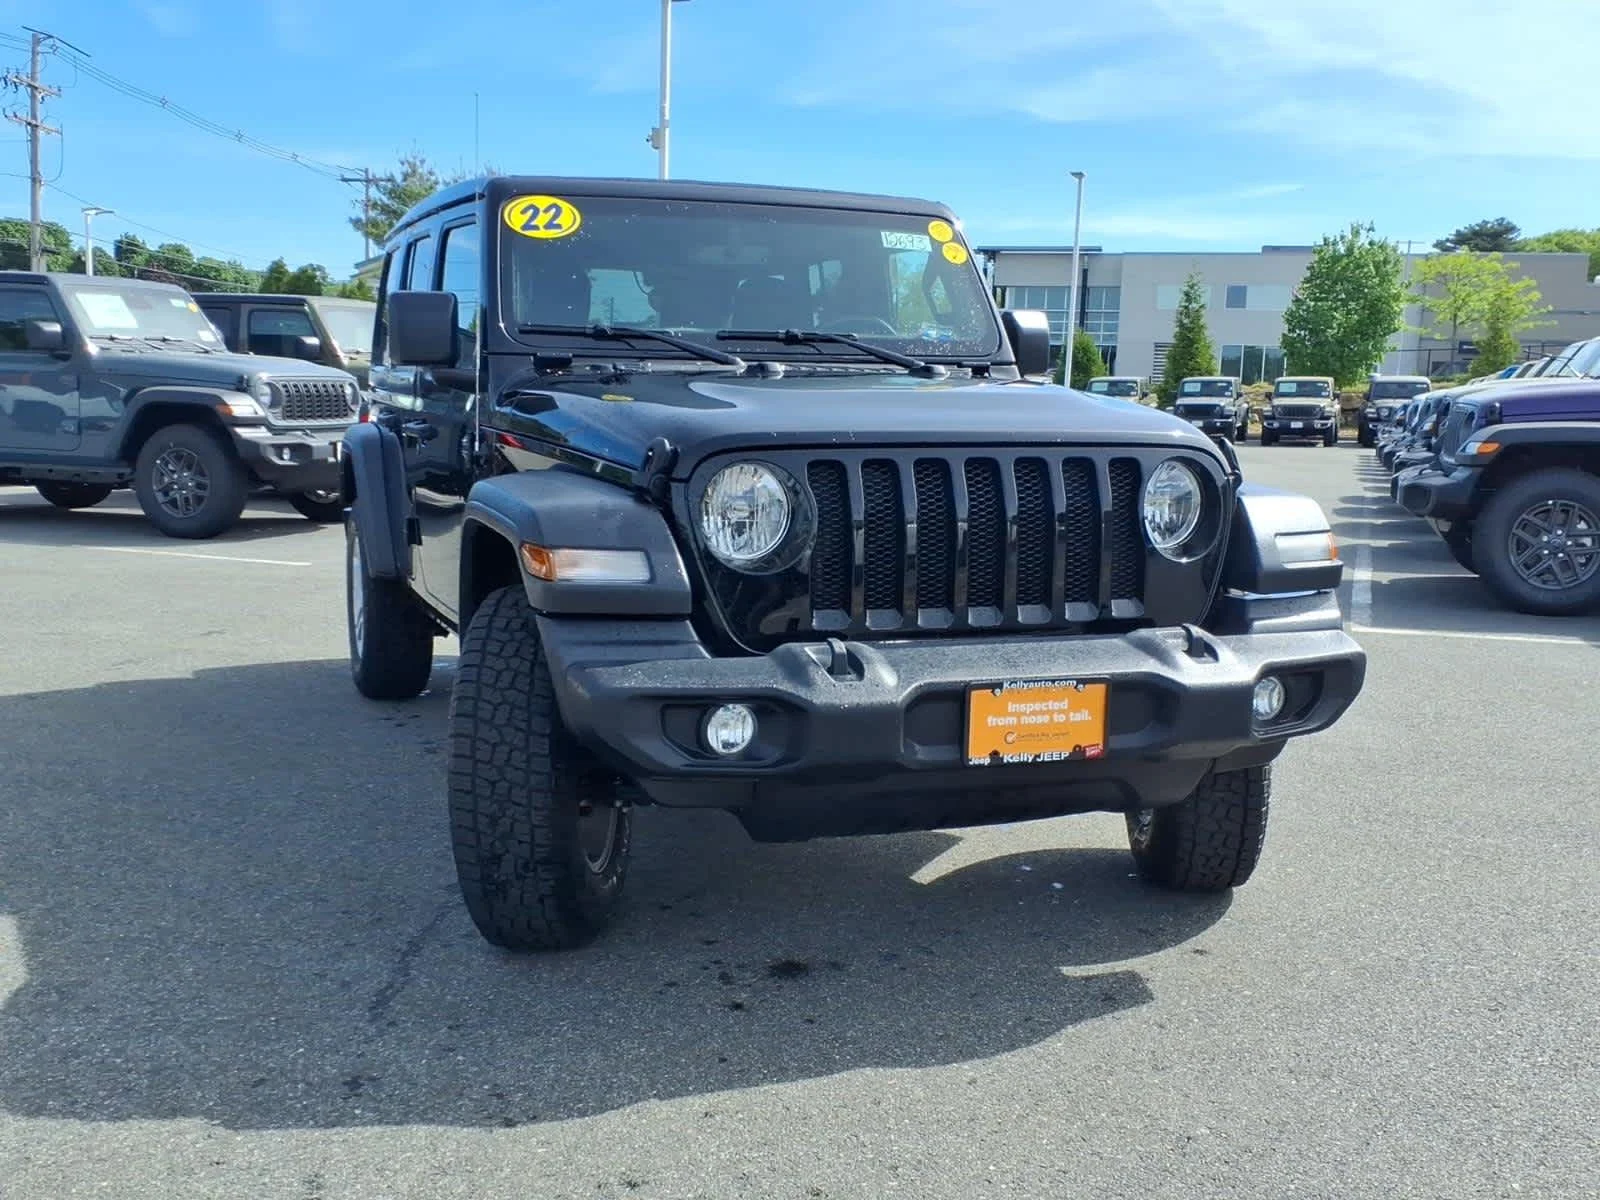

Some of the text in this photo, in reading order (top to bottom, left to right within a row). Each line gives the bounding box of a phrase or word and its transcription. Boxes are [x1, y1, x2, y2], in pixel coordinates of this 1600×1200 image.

[519, 203, 563, 231] 22
[1003, 679, 1077, 690] Kellyauto.com
[1007, 699, 1069, 714] Inspected
[987, 709, 1092, 727] from nose to tail.
[968, 755, 991, 766] Jeep
[1003, 751, 1070, 763] Kelly JEEP
